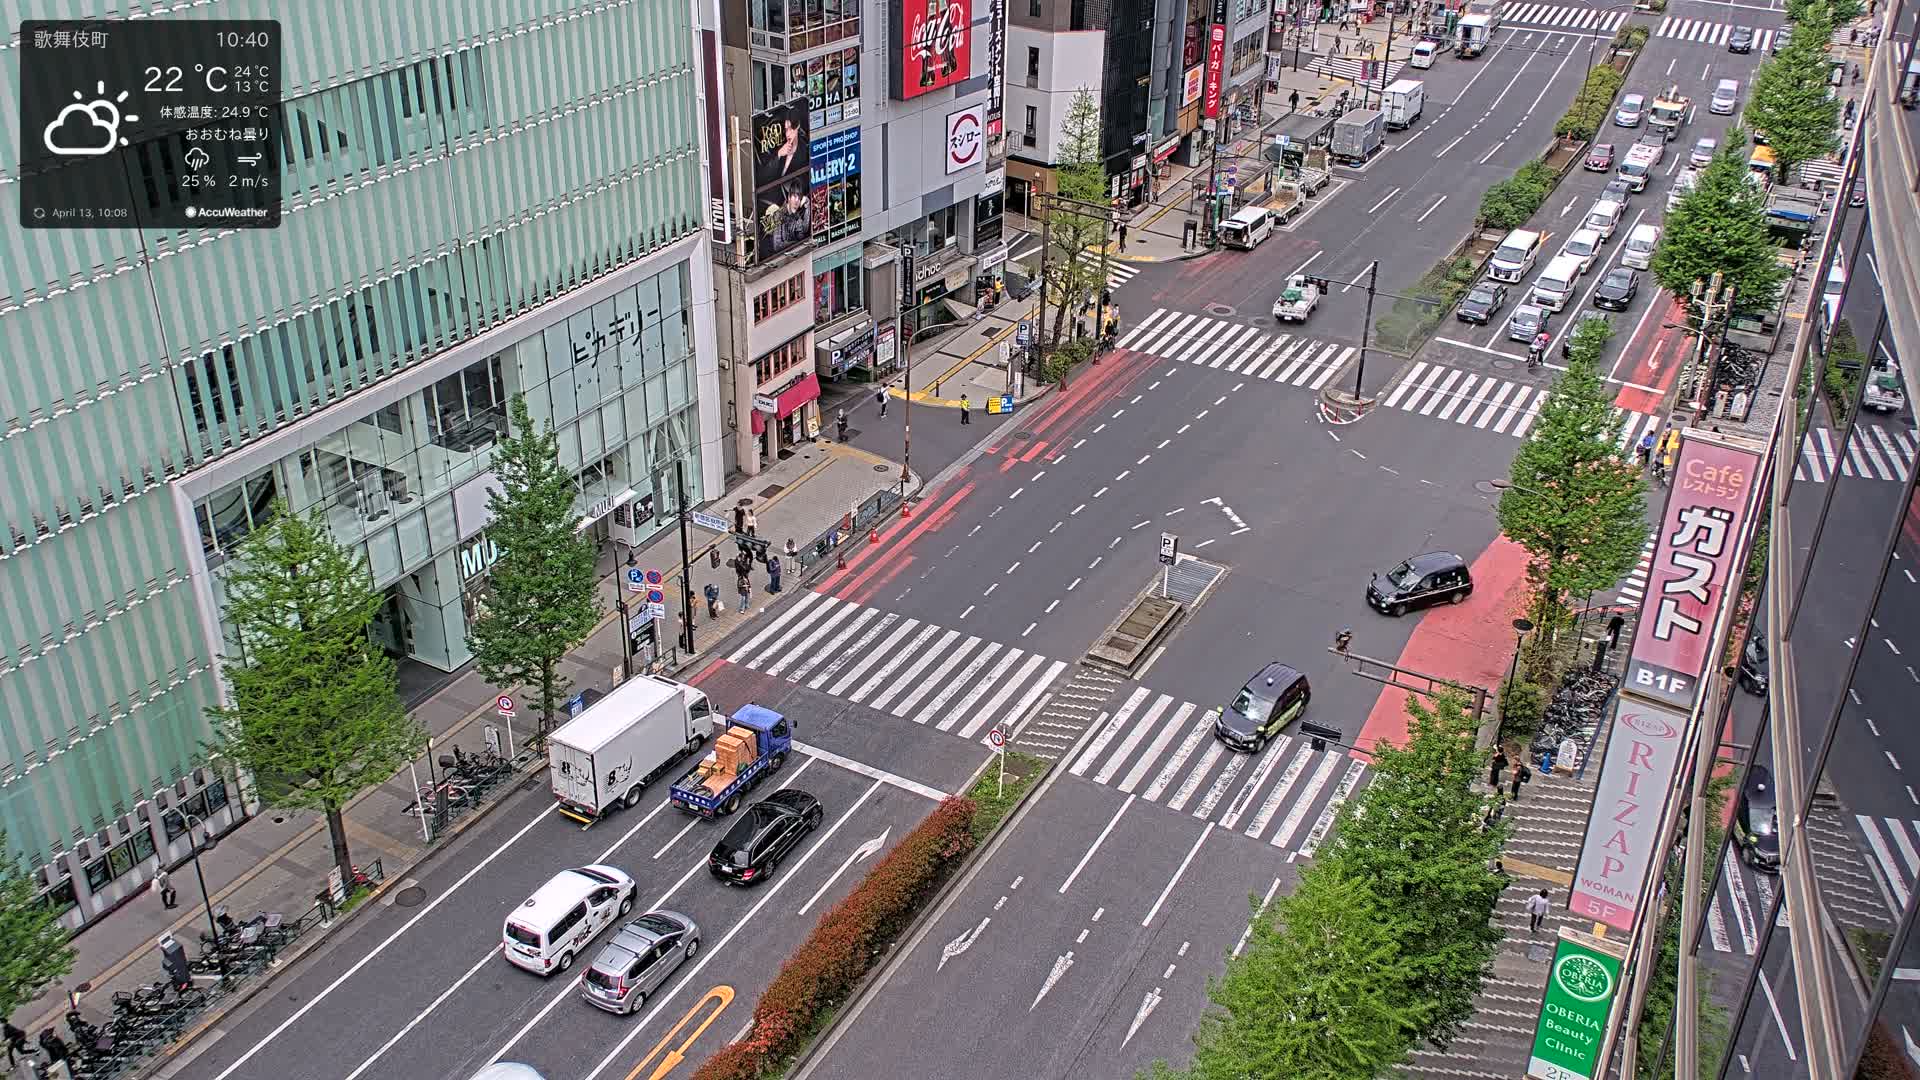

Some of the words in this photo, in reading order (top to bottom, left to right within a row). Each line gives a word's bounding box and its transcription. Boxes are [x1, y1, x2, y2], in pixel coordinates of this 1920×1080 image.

[1208, 43, 1222, 109] バーガーキング
[826, 86, 854, 105] HALL
[845, 131, 858, 141] SHOP
[950, 132, 981, 150] スシロー
[711, 197, 725, 231] MUJI
[904, 248, 911, 256] P
[573, 309, 658, 368] ピカデリー
[1020, 325, 1027, 333] P
[832, 351, 841, 364] P
[1001, 398, 1008, 407] P
[1686, 458, 1744, 487] Café
[1682, 478, 1741, 501] レストラン
[1163, 538, 1171, 547] P
[461, 540, 509, 579] MU
[1653, 505, 1734, 641] ガスト
[1636, 669, 1687, 694] B1F
[1601, 740, 1655, 879] RIZAP
[1581, 877, 1635, 903] WOMAN
[1587, 899, 1616, 920] 5F
[1562, 969, 1603, 990] OBERIA
[1546, 1003, 1600, 1032] OBERIA
[1546, 1019, 1593, 1046] Beauty
[1545, 1038, 1586, 1060] Clinic
